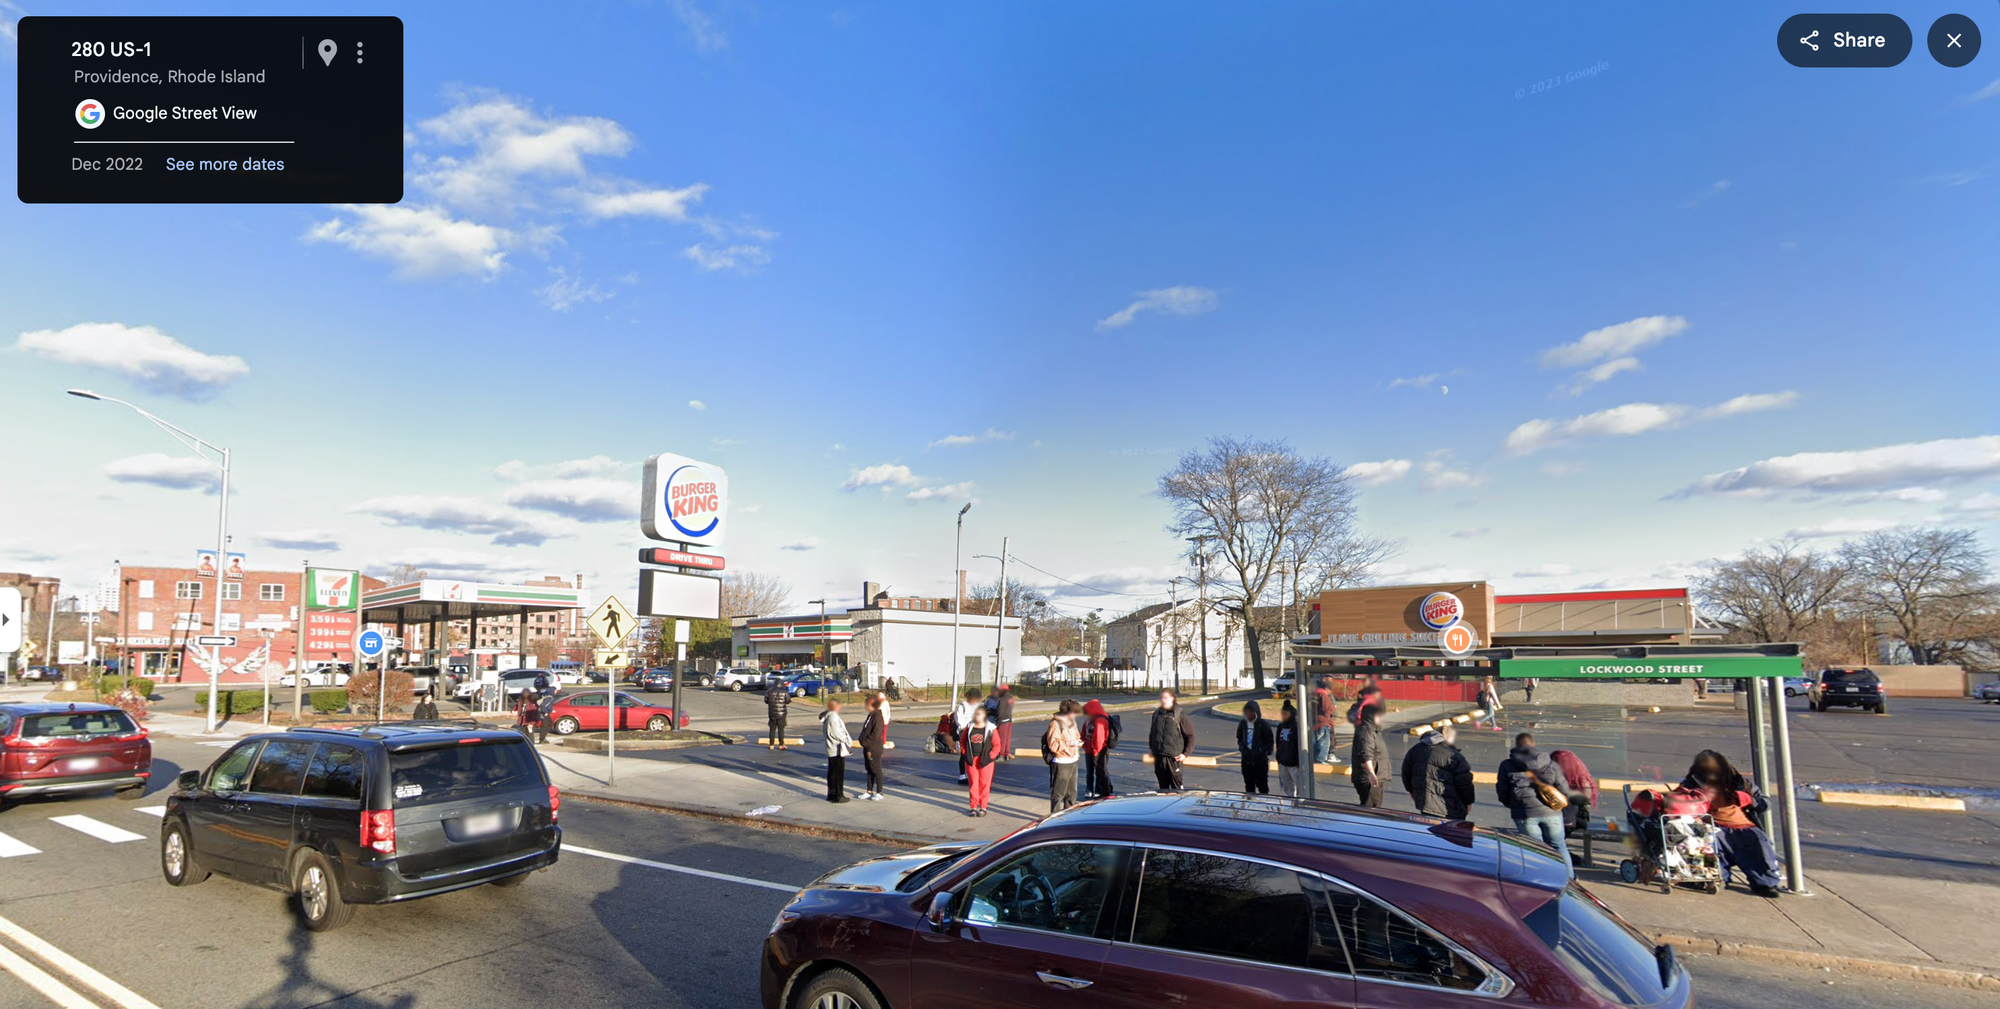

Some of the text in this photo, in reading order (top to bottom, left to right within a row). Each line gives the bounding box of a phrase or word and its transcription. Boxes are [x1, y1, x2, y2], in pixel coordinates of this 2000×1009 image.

[671, 482, 717, 499] BURGER
[672, 494, 719, 518] KING
[670, 553, 713, 565] DRIVE THRU
[1425, 598, 1456, 612] BURGER
[1426, 605, 1458, 621] KING
[1580, 665, 1703, 674] LOCKWOOD STREET
